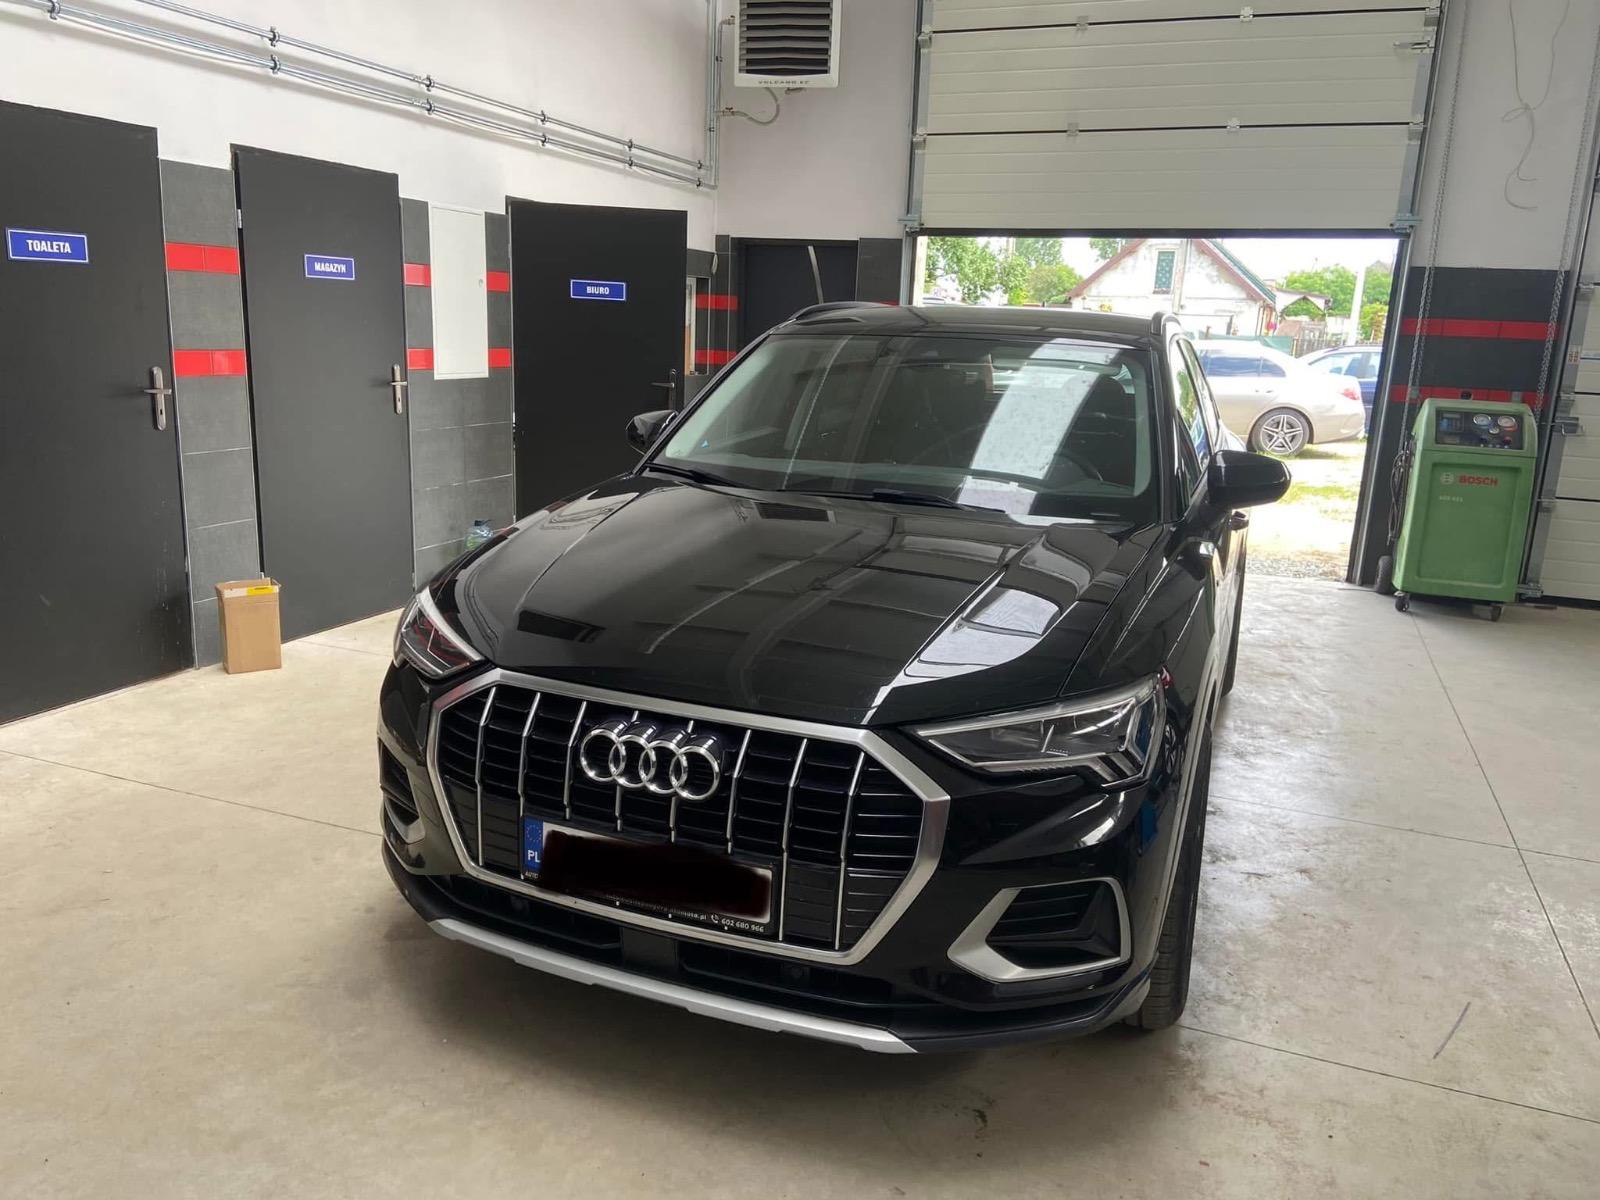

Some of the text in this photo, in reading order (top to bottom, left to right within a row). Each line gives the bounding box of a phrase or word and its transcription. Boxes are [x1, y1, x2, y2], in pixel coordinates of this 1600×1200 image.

[26, 239, 72, 254] TOALETA
[314, 261, 346, 274] MAGAZYN
[586, 286, 610, 295] BIURO
[1458, 474, 1499, 487] BOSCH
[527, 849, 541, 863] PL
[721, 918, 735, 927] 602
